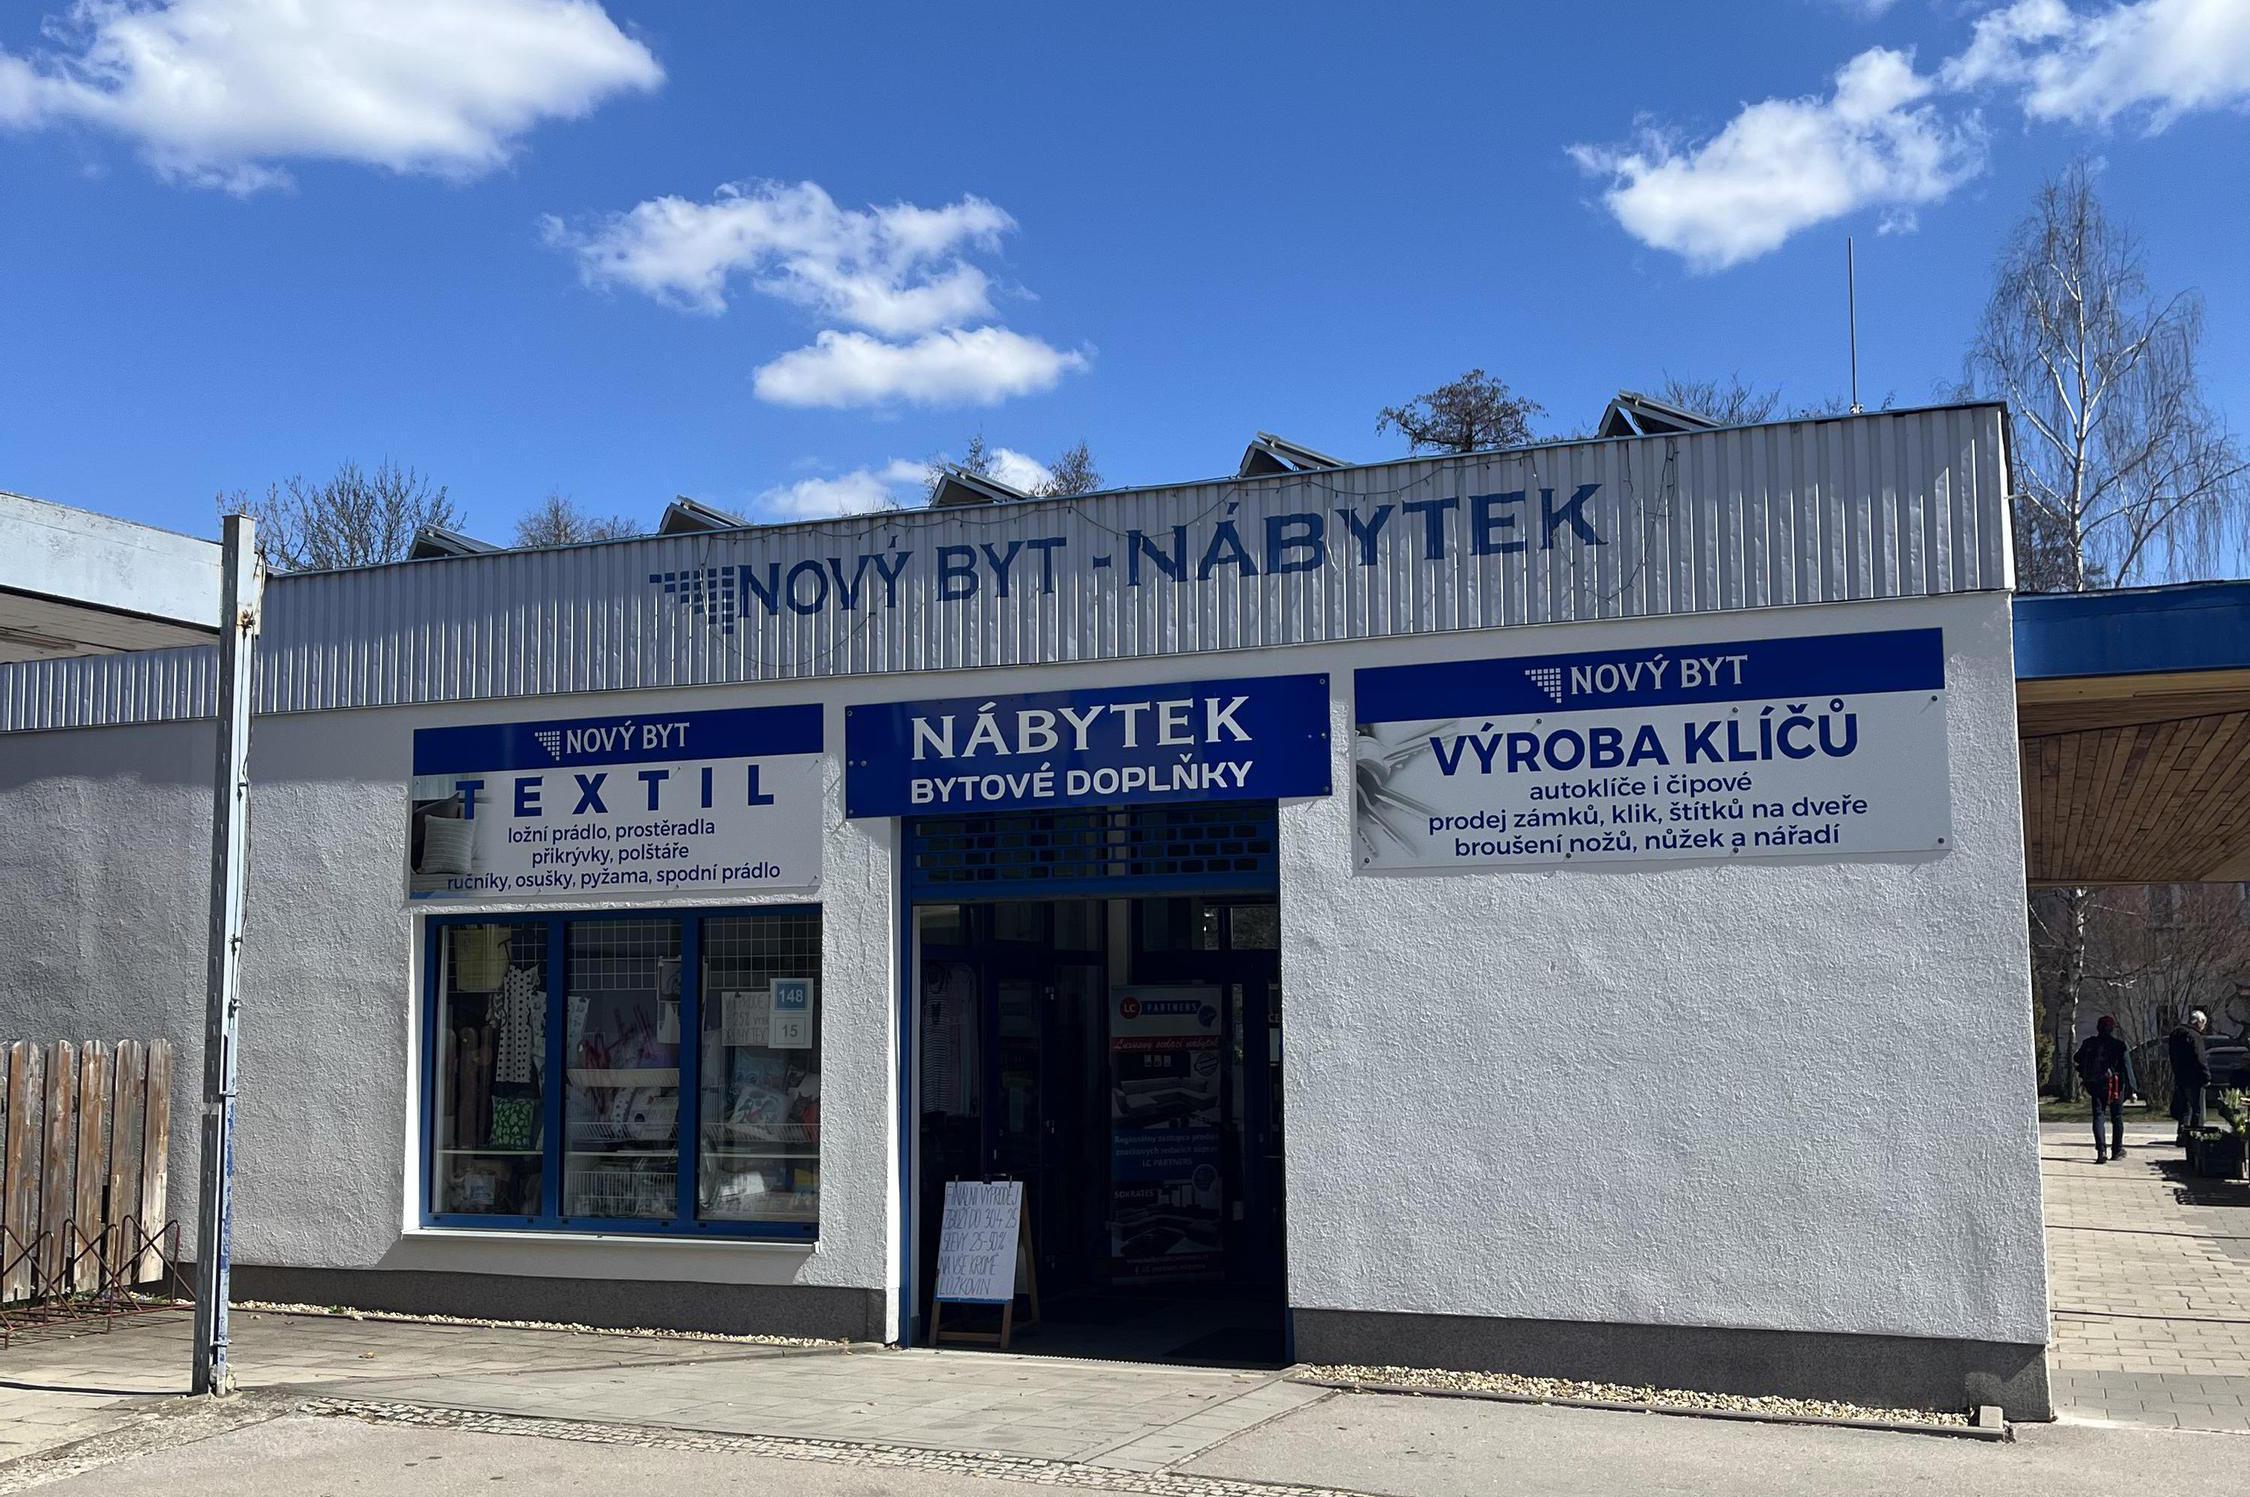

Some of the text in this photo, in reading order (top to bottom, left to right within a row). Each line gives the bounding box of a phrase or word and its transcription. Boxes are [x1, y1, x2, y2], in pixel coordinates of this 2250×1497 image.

[737, 535, 914, 618] NOVÝ
[935, 536, 1068, 602] BYT
[1126, 482, 1609, 586] NÁBYTEK
[1570, 653, 1748, 696] NOVÝ BYT
[566, 720, 690, 755] NOVÝ BYT
[911, 695, 1253, 761] NÁBYTEK
[1429, 698, 1858, 776] VÝROBA KLÍČŮ
[910, 752, 1254, 805] BYTOVÉ DOPLŇKY
[1530, 771, 1752, 801] autoklíče i čipové
[1429, 794, 1868, 836] prodej zámků, klik, štítků na dveře
[508, 819, 715, 846] ložní prádlo, prostěradla
[1455, 824, 1841, 857] broušení nožů, nůžek a nářadí
[532, 841, 689, 868] přikrývky, polštáře
[447, 861, 780, 894] ručníky, osušky, pyžama, spodní prádlo
[779, 989, 804, 1003] 148
[782, 1024, 798, 1037] 15
